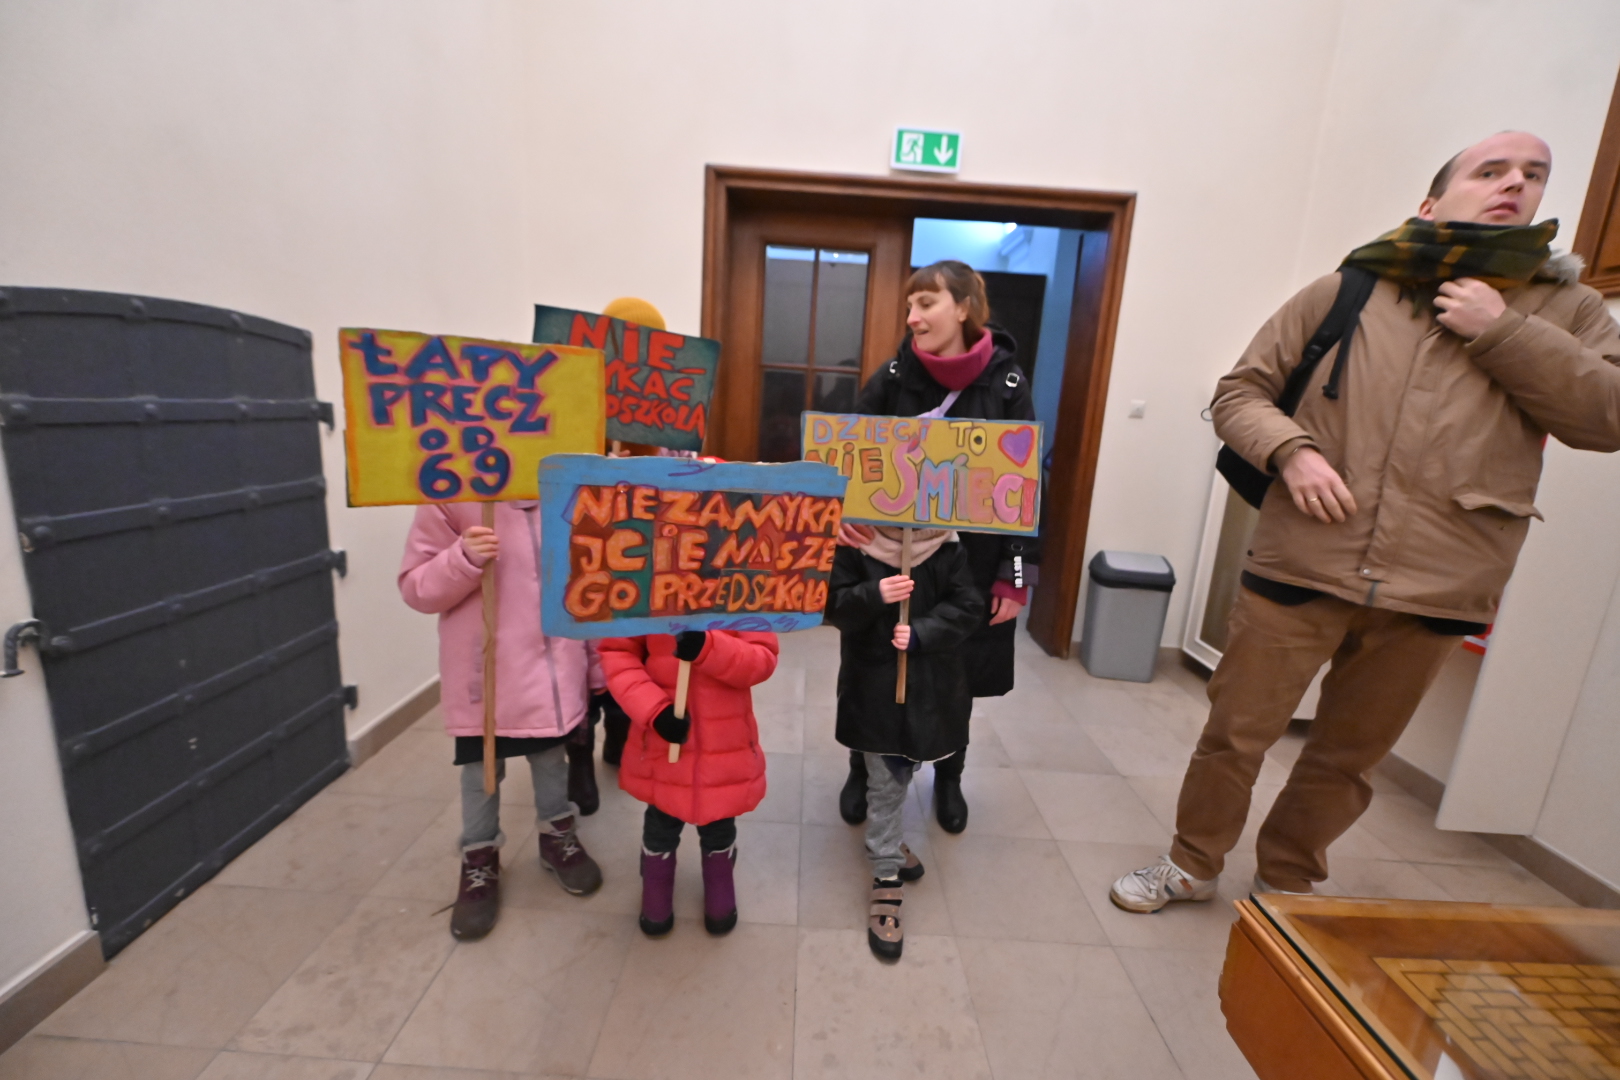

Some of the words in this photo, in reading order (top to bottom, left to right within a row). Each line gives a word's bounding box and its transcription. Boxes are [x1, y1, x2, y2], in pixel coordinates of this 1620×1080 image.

[367, 383, 548, 433] PRECZ
[949, 420, 987, 456] TO
[418, 447, 511, 499] 69
